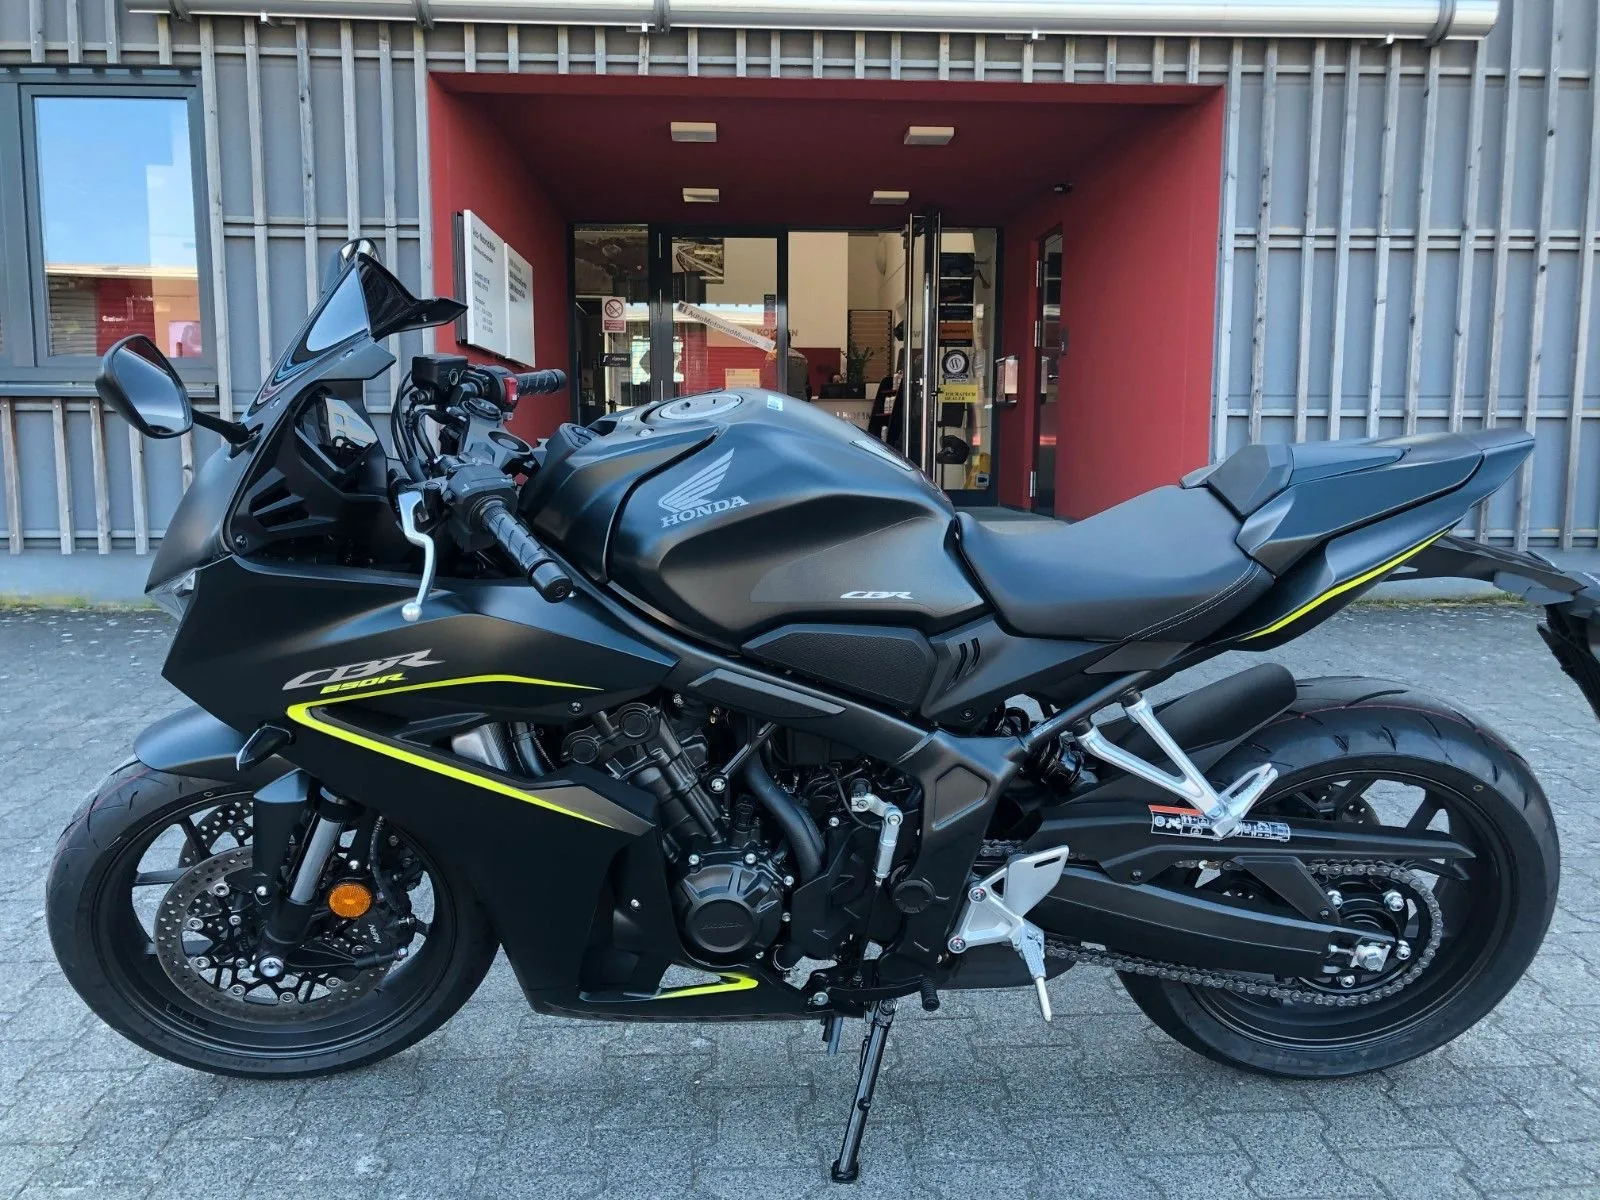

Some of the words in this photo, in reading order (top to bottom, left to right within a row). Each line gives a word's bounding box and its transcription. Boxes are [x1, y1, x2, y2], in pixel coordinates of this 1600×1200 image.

[661, 496, 750, 528] HONDA
[840, 591, 914, 600] CBR
[282, 648, 445, 691] CBR
[320, 672, 408, 694] 650R
